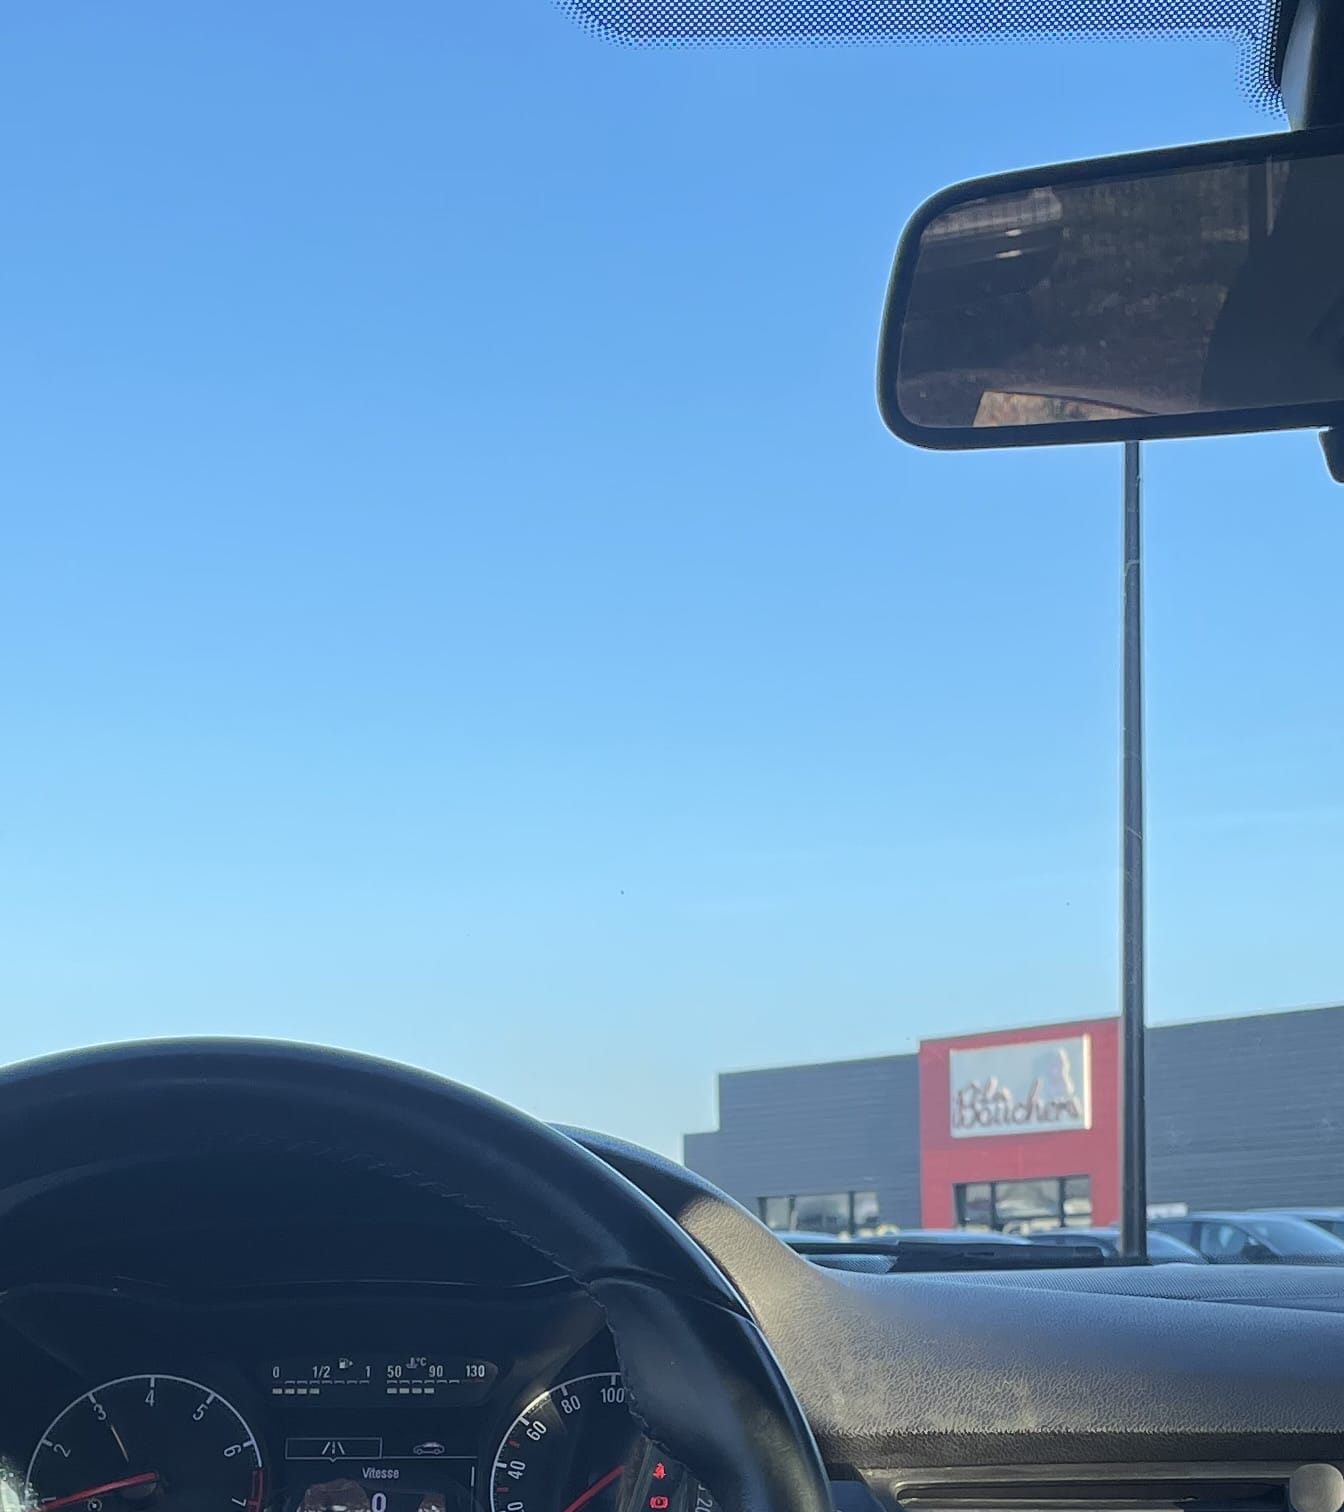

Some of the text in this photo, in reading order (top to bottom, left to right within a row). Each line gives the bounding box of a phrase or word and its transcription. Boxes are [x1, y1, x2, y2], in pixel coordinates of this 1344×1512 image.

[272, 1365, 371, 1378] 0 1/2 1
[387, 1365, 485, 1378] 50 90 130
[145, 1389, 155, 1407] 4
[599, 1387, 624, 1404] 100
[93, 1403, 107, 1421] 3
[192, 1403, 209, 1421] 5
[560, 1395, 581, 1415] 80
[526, 1420, 547, 1441] 60
[52, 1443, 71, 1458] 2
[223, 1444, 242, 1458] 6
[362, 1466, 399, 1480] Vitesse
[507, 1460, 526, 1480] 40
